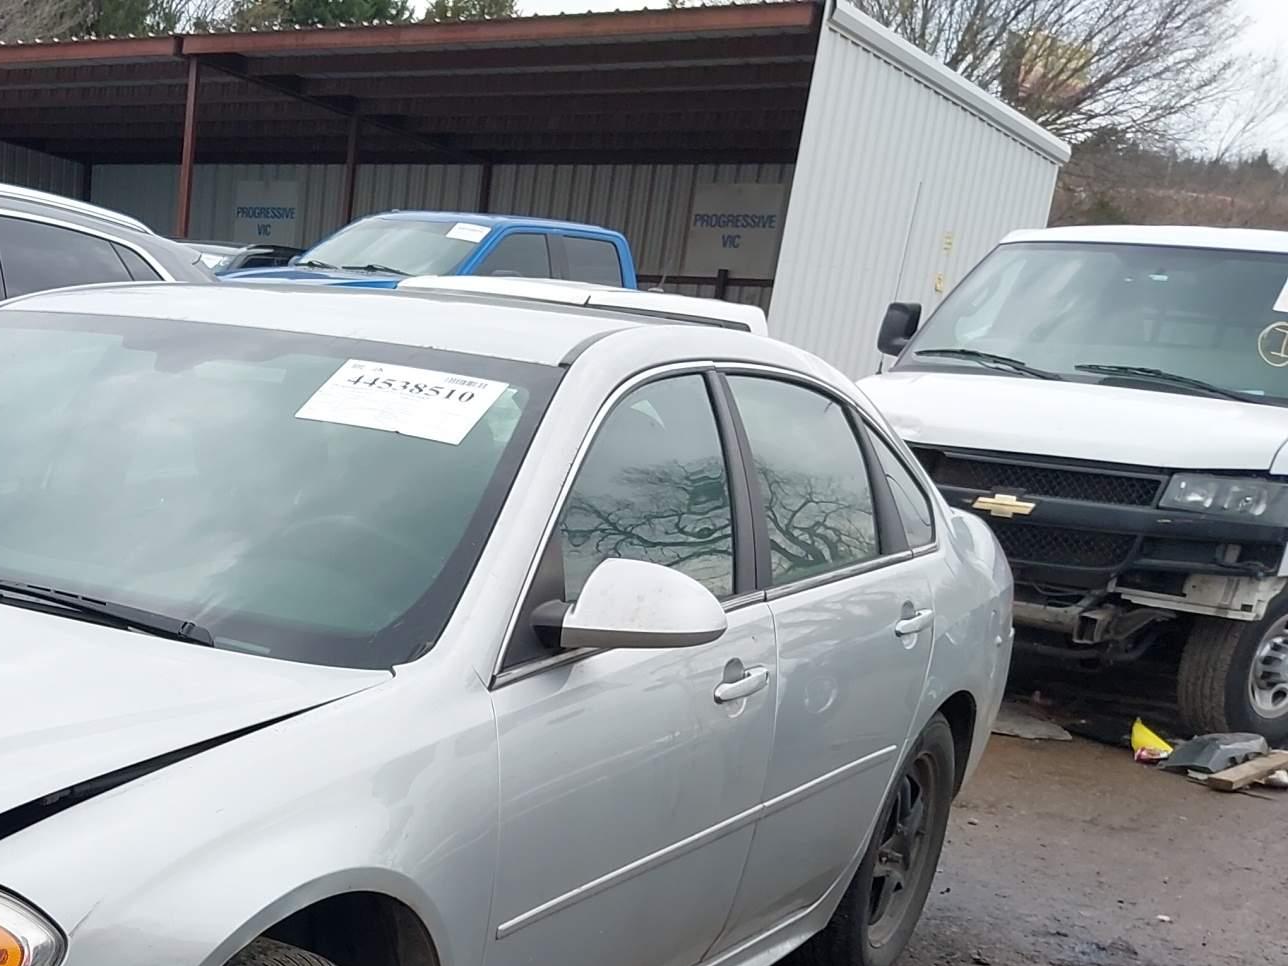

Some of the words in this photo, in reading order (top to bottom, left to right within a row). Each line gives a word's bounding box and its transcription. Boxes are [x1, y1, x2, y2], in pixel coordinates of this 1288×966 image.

[236, 206, 296, 219] PROGRESSIVE
[693, 213, 777, 229] PROGRESSIVE
[257, 223, 272, 236] VIC
[721, 234, 742, 248] VIC
[347, 374, 476, 403] 44538510
